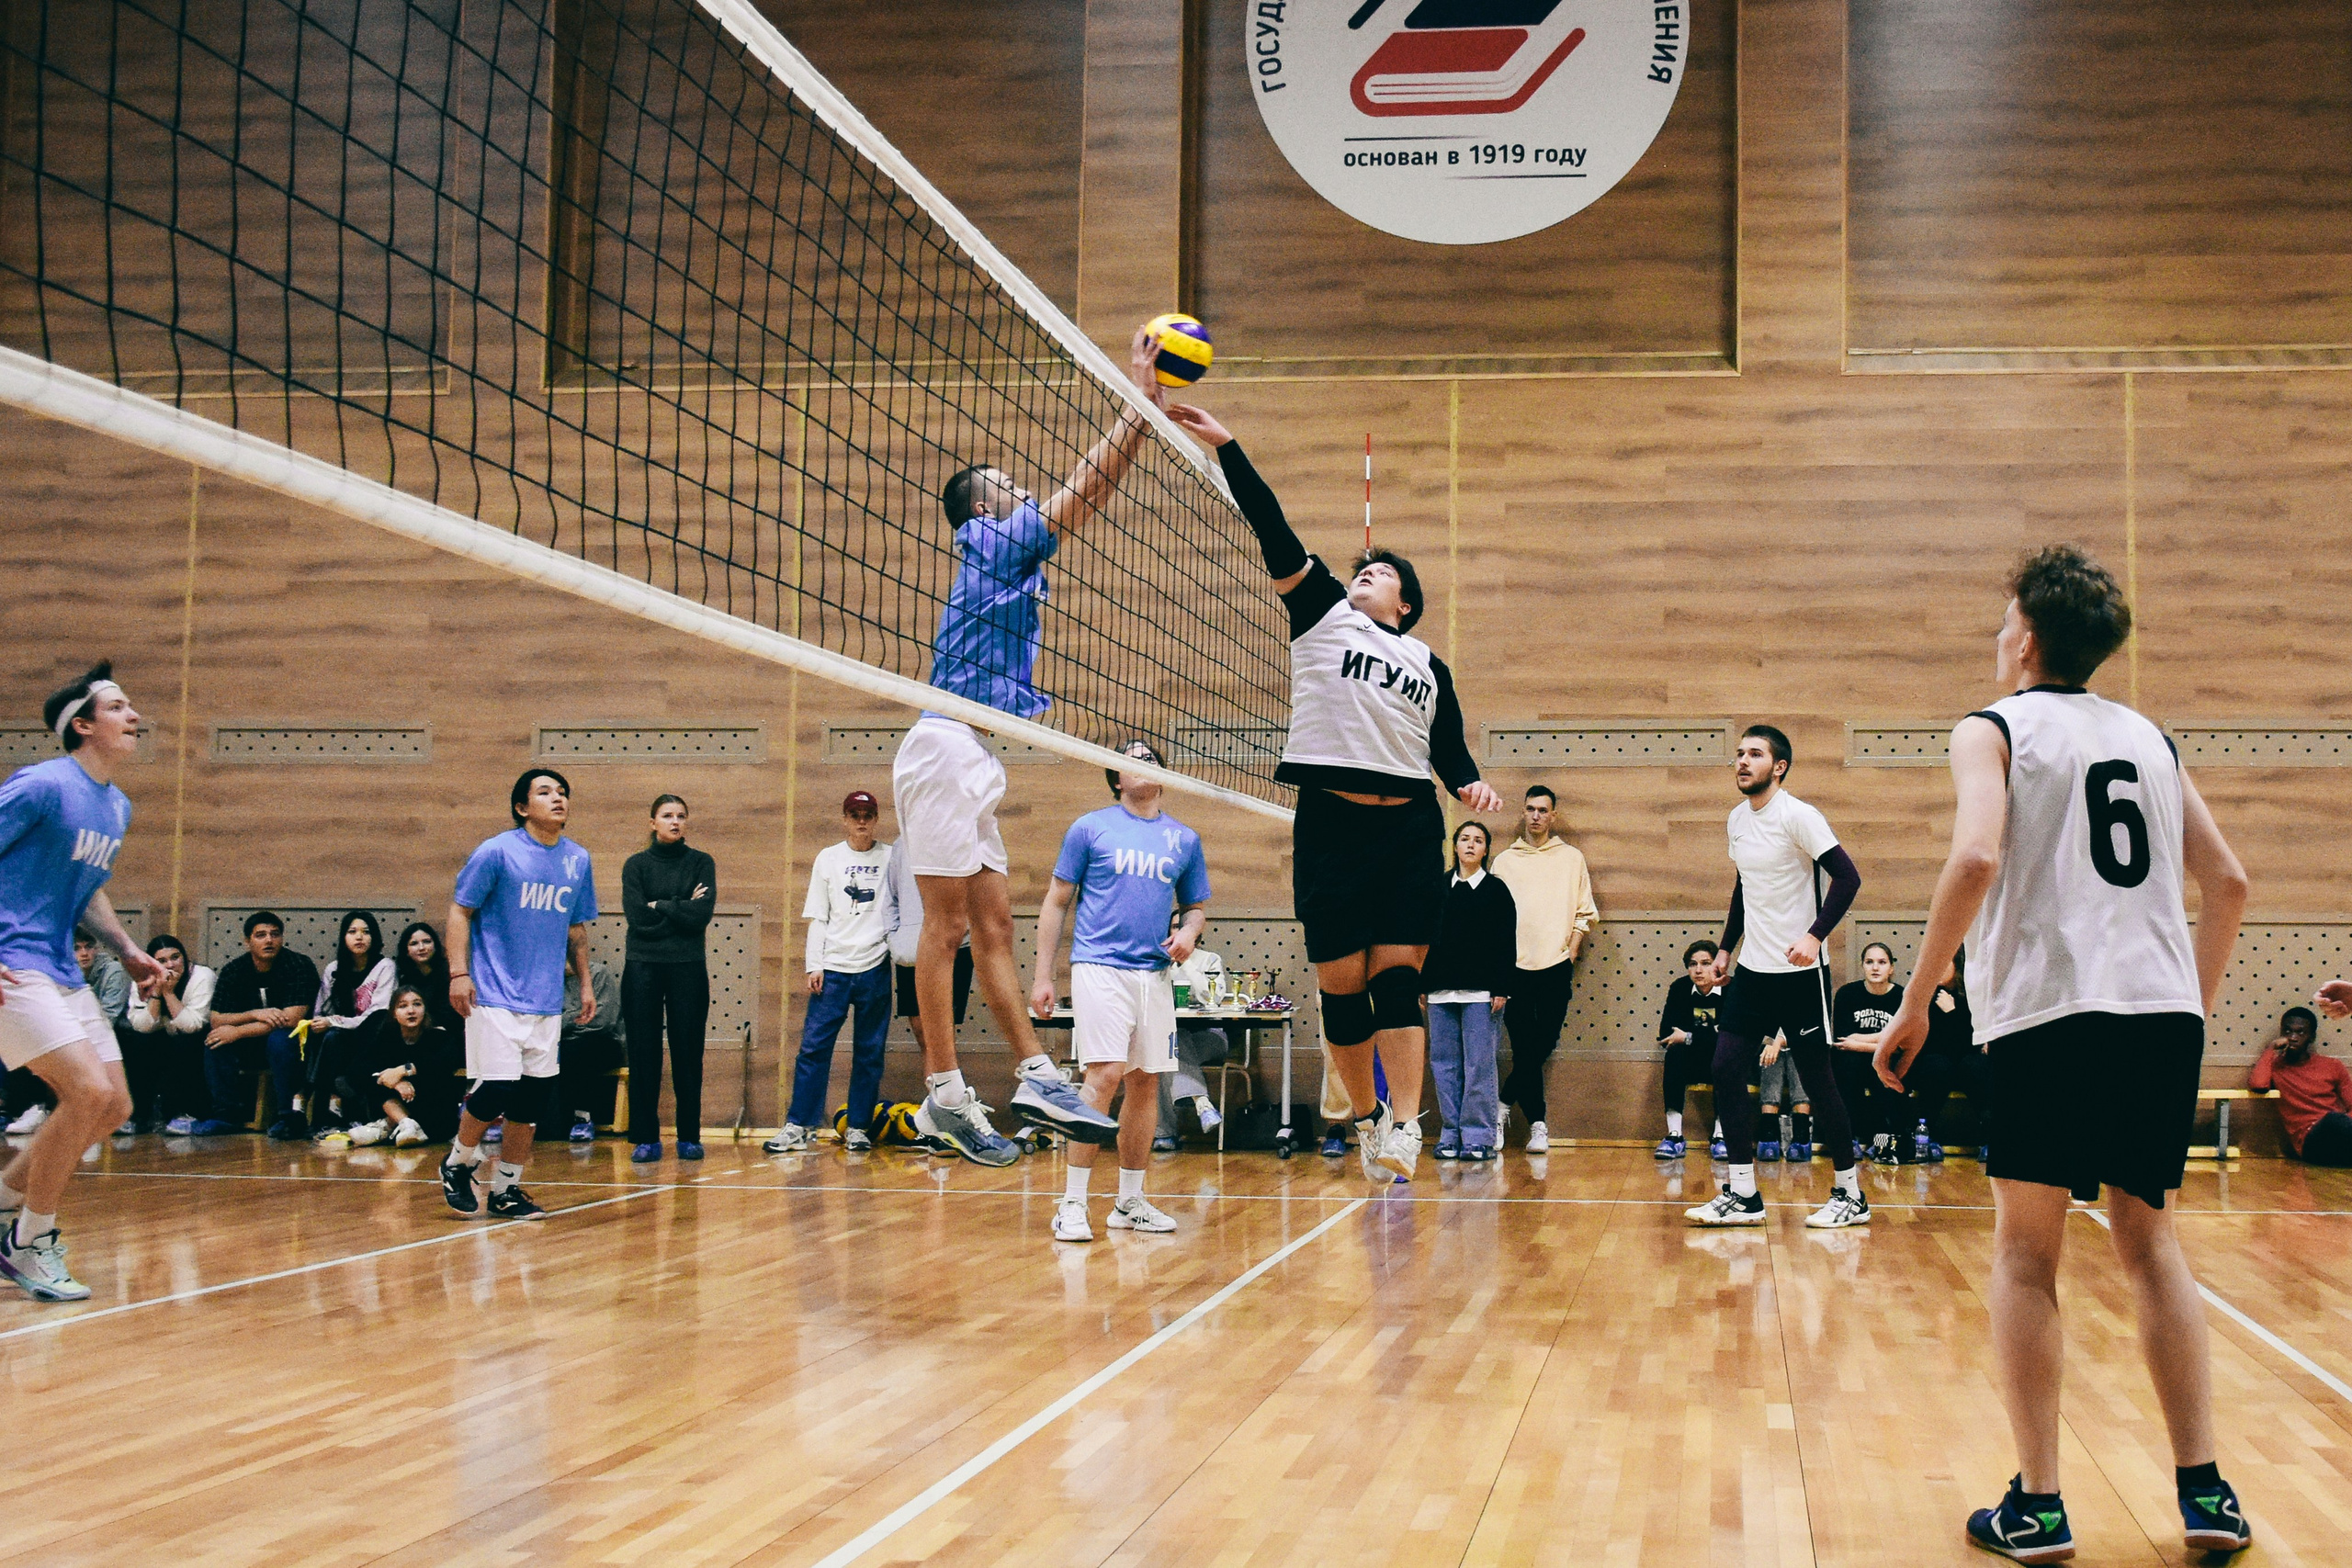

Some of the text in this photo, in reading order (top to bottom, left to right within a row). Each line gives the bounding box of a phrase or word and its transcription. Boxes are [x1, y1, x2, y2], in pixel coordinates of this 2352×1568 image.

[1256, 0, 1286, 93] ГОСУД
[1647, 0, 1679, 84] ЕНИЯ
[1344, 144, 1588, 167] основан в 1919 году
[2085, 759, 2151, 888] 6
[1114, 848, 1175, 884] ИИС
[519, 881, 573, 913] ИИС
